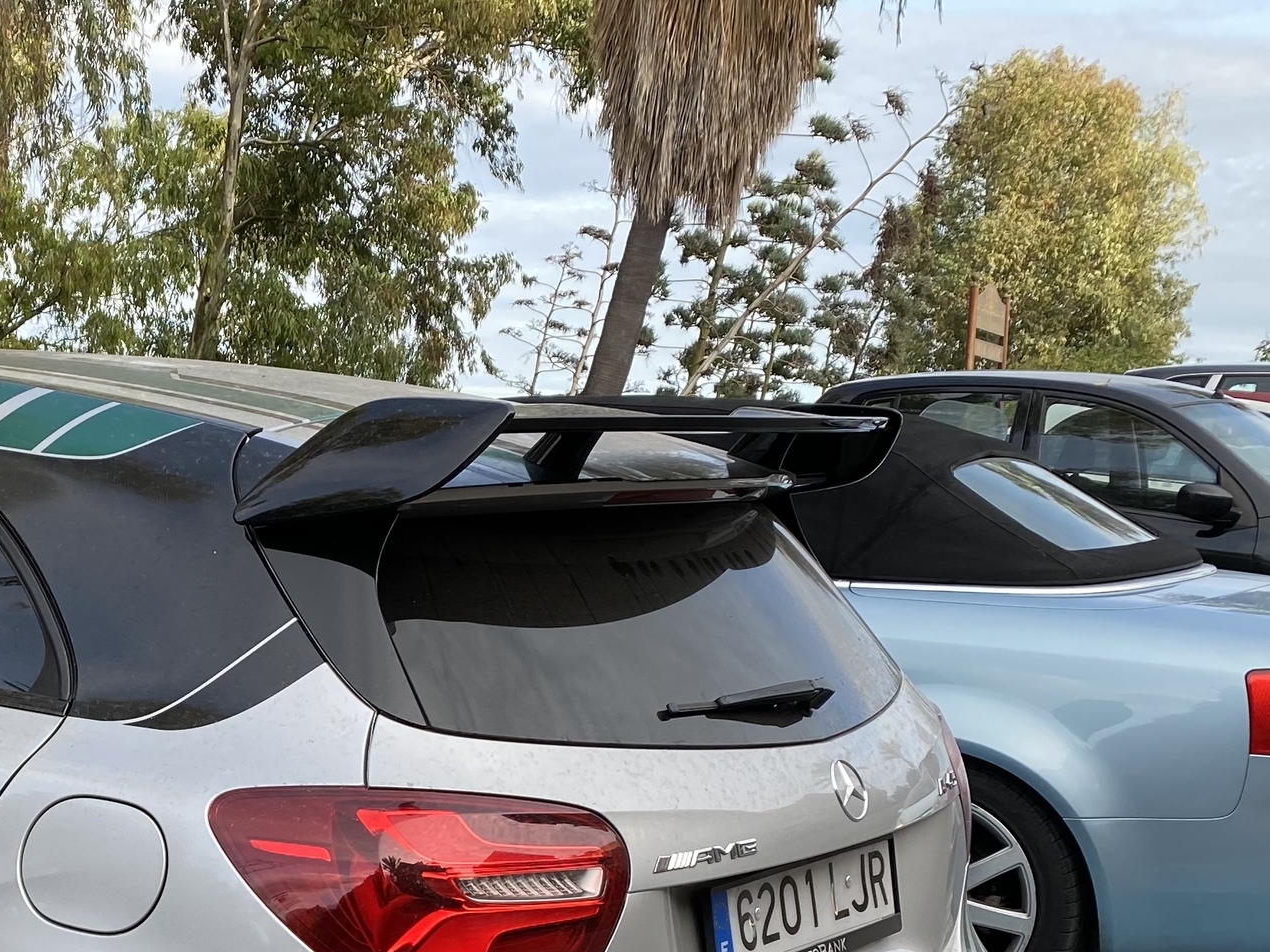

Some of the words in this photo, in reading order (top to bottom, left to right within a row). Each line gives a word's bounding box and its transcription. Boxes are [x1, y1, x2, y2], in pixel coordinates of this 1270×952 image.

[689, 838, 758, 868] AMG
[737, 868, 819, 952] 6201
[828, 850, 889, 921] LJR
